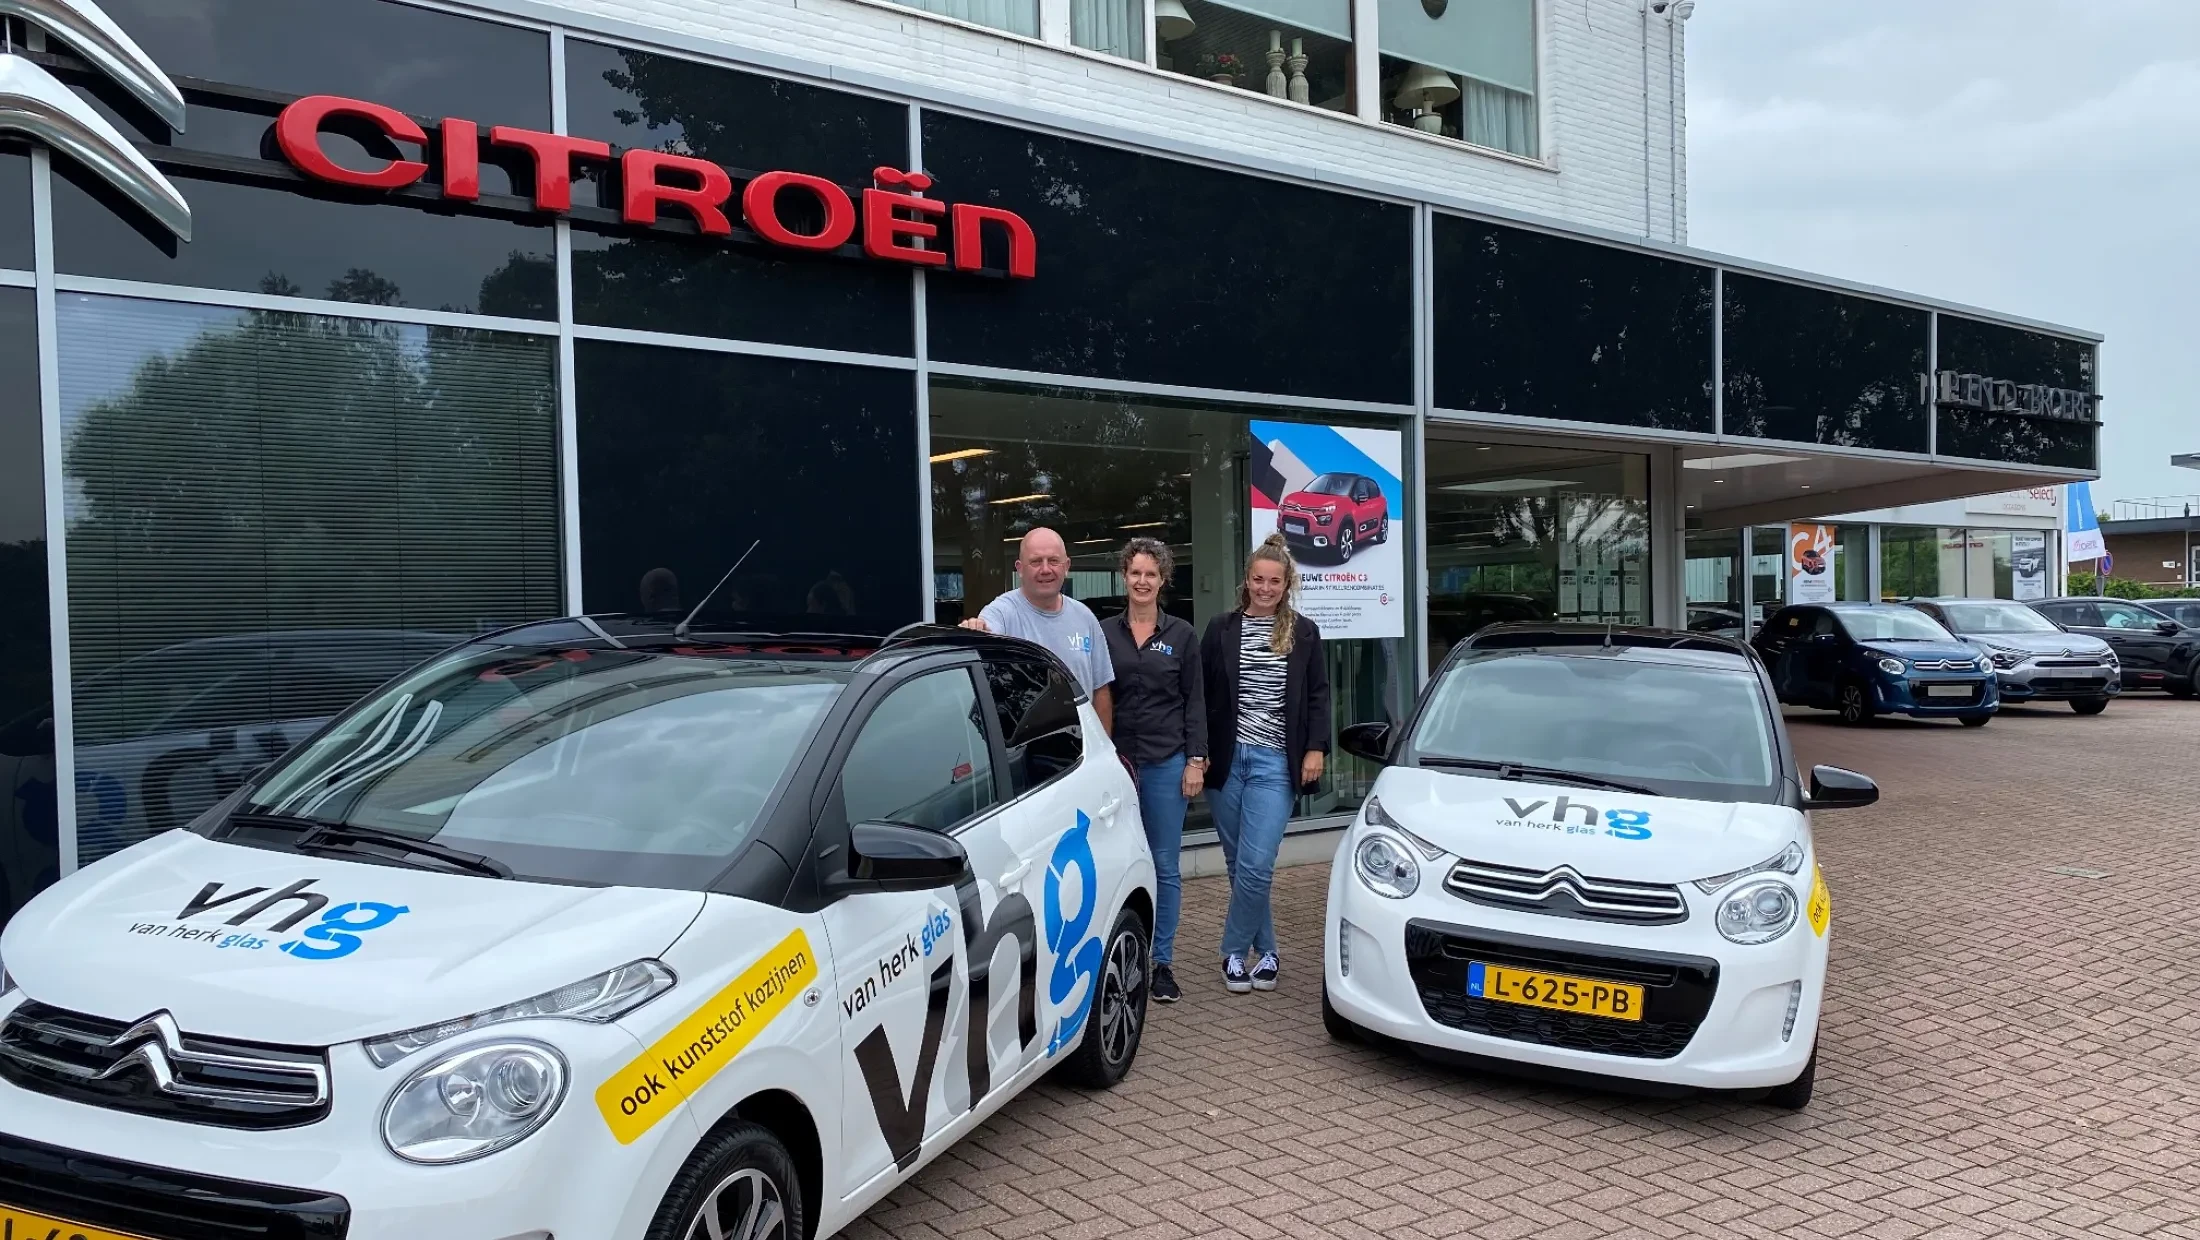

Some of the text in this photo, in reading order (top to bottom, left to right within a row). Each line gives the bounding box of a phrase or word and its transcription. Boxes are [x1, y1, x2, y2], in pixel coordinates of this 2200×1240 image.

[275, 95, 1036, 279] CITROËN
[1792, 525, 1832, 570] C4
[1301, 573, 1323, 582] EUWE
[1324, 572, 1356, 582] CITROËN
[1067, 632, 1090, 652] vhg
[1152, 640, 1172, 655] vhg
[1496, 819, 1596, 835] van herk glas
[1502, 796, 1653, 840] vhg
[128, 921, 270, 950] van herk glas
[175, 878, 410, 960] vhg
[843, 907, 951, 1020] van herk glas
[853, 808, 1103, 1174] vhg
[1470, 982, 1482, 992] NL
[1495, 971, 1629, 1014] L-625-PB
[620, 950, 806, 1116] ook kunststof kozijnen
